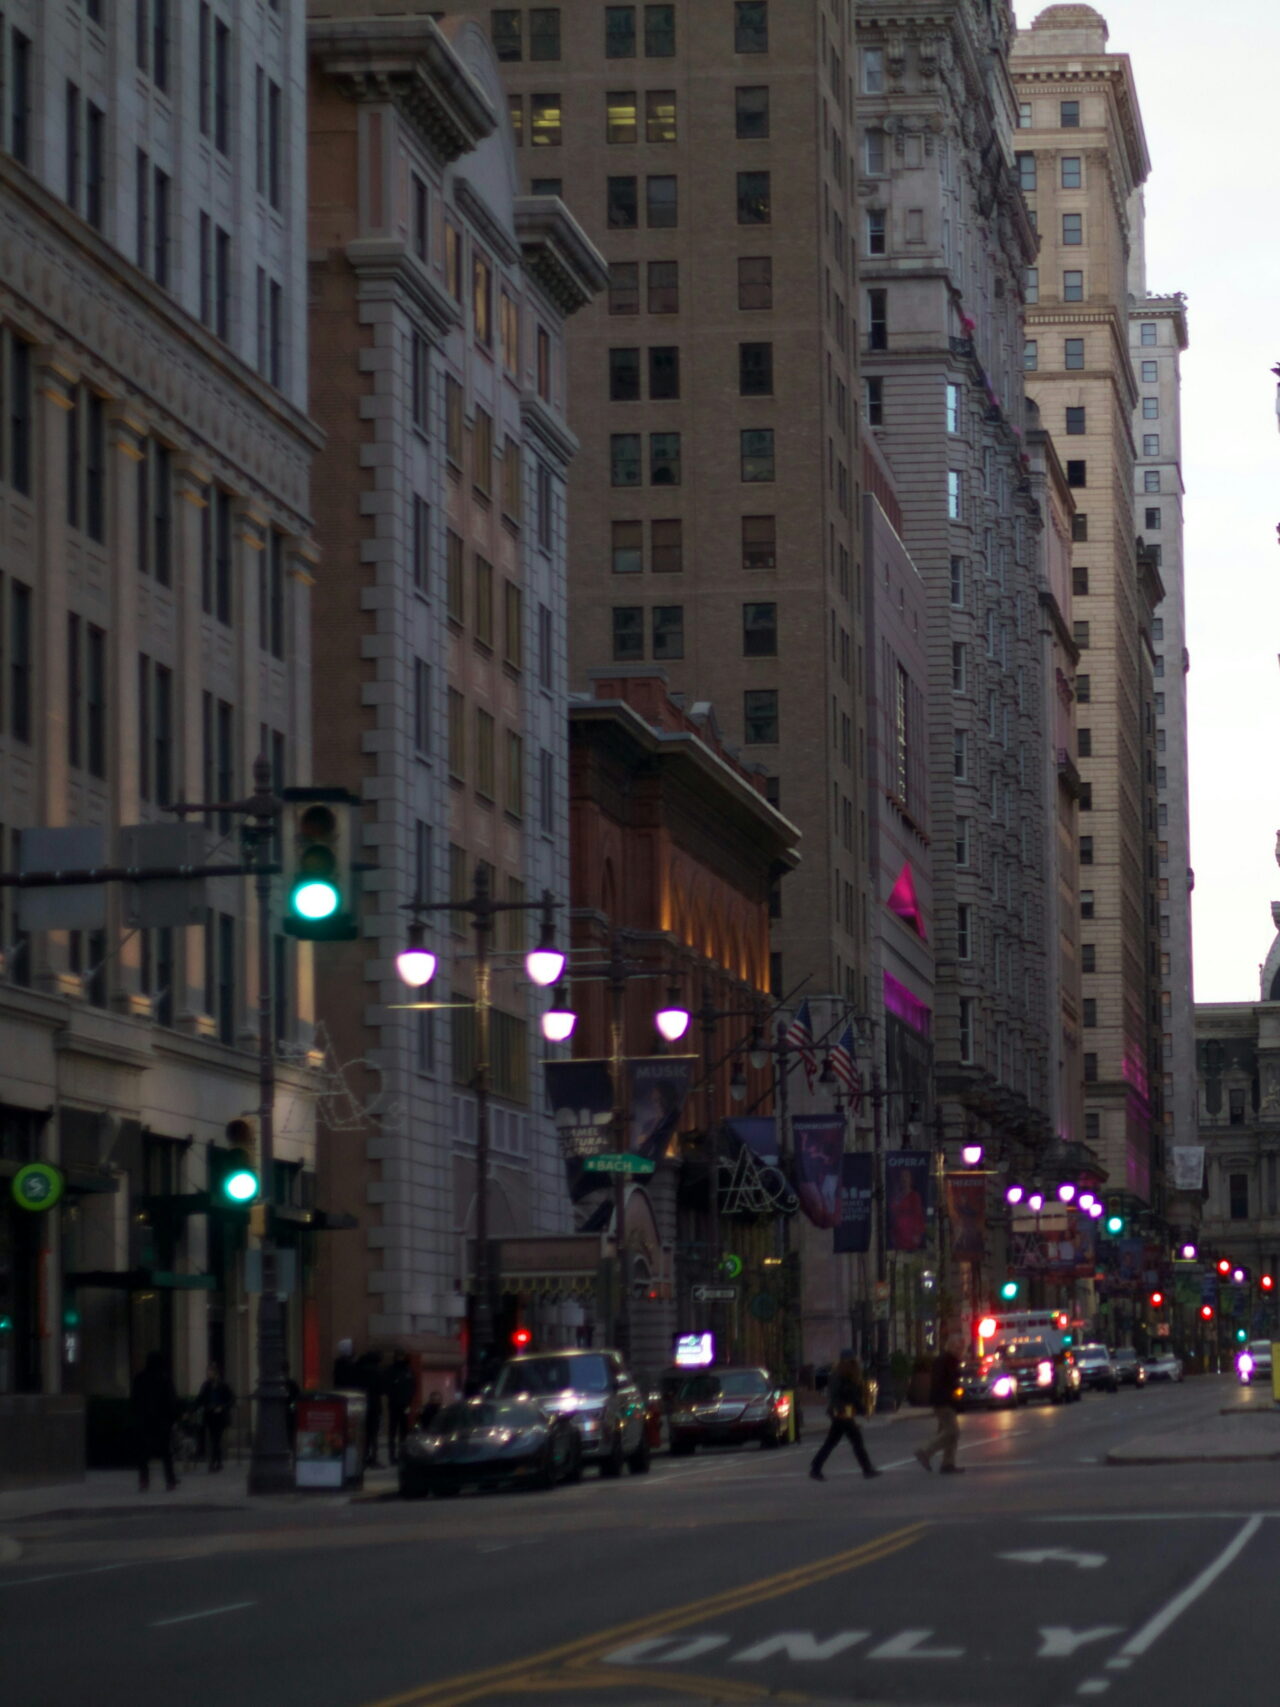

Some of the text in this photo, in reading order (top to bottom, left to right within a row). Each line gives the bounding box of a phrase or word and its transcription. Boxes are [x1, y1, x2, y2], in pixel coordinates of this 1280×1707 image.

[636, 1063, 689, 1079] MUSIC
[597, 1160, 632, 1171] BACH
[888, 1157, 926, 1167] OPERA
[598, 1626, 1126, 1664] ONLY
